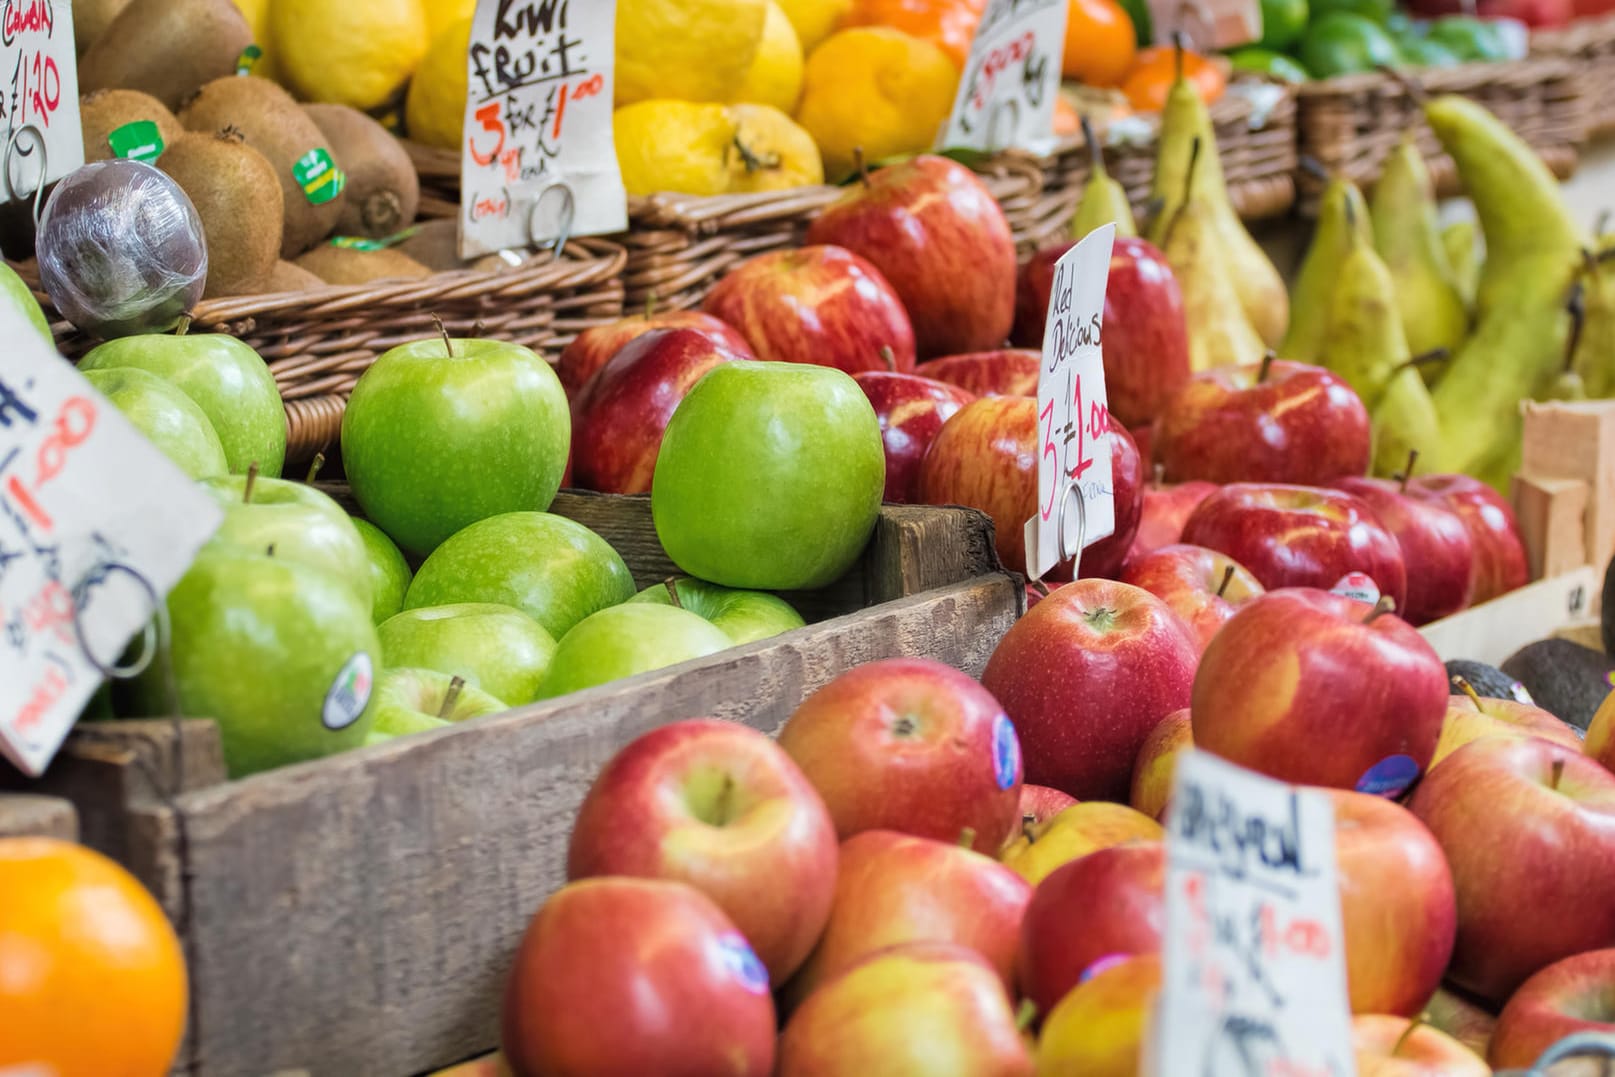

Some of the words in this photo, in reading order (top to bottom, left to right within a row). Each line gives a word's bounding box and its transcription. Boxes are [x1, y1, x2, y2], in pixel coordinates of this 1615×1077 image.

[469, 101, 506, 167] 3
[1053, 263, 1075, 318] Red
[1049, 313, 1102, 373] Delicious
